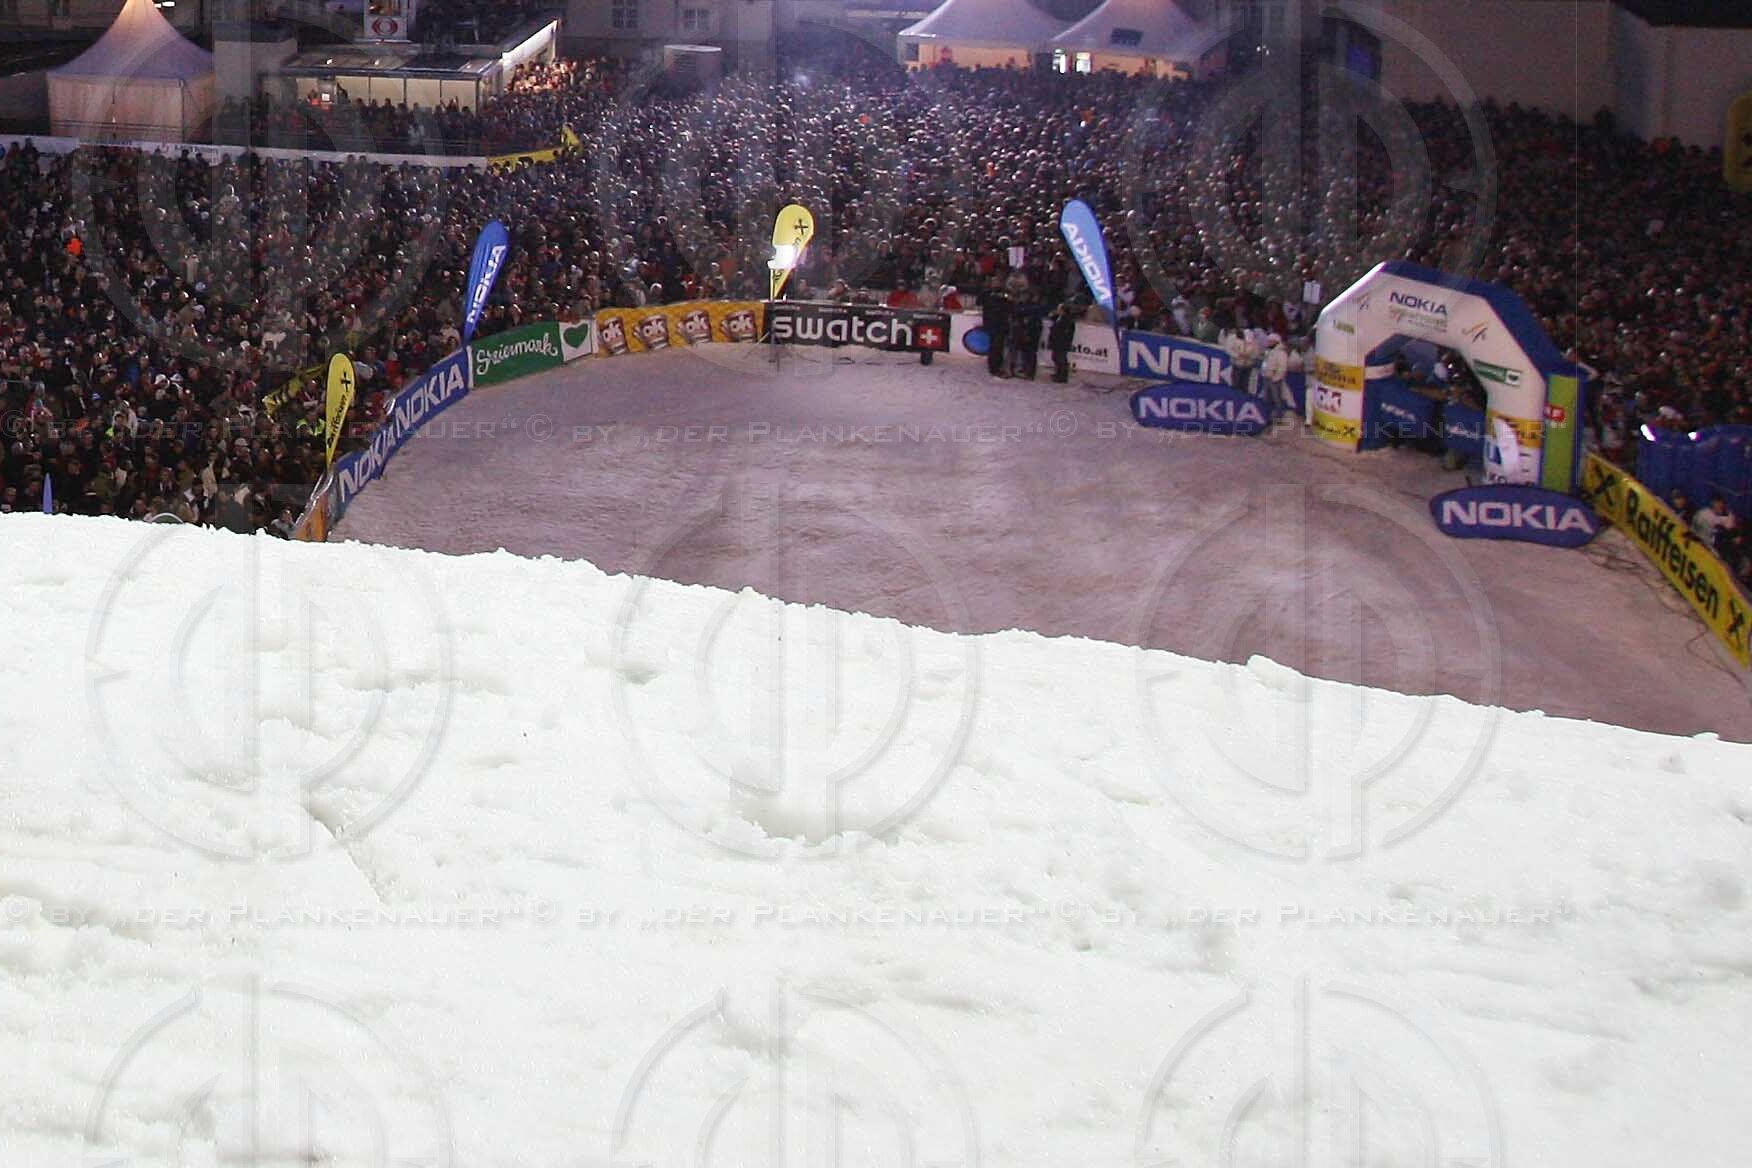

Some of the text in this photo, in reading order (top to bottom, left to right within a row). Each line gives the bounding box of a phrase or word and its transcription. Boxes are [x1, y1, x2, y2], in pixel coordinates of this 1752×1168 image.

[1389, 291, 1449, 317] NOKIA
[773, 315, 913, 347] swatch
[394, 363, 465, 439] NOKIA
[1138, 396, 1266, 424] NOKIA
[338, 424, 397, 503] NOKIA
[1441, 500, 1594, 533] NOKIA
[1625, 489, 1720, 619] Raiffeisen
